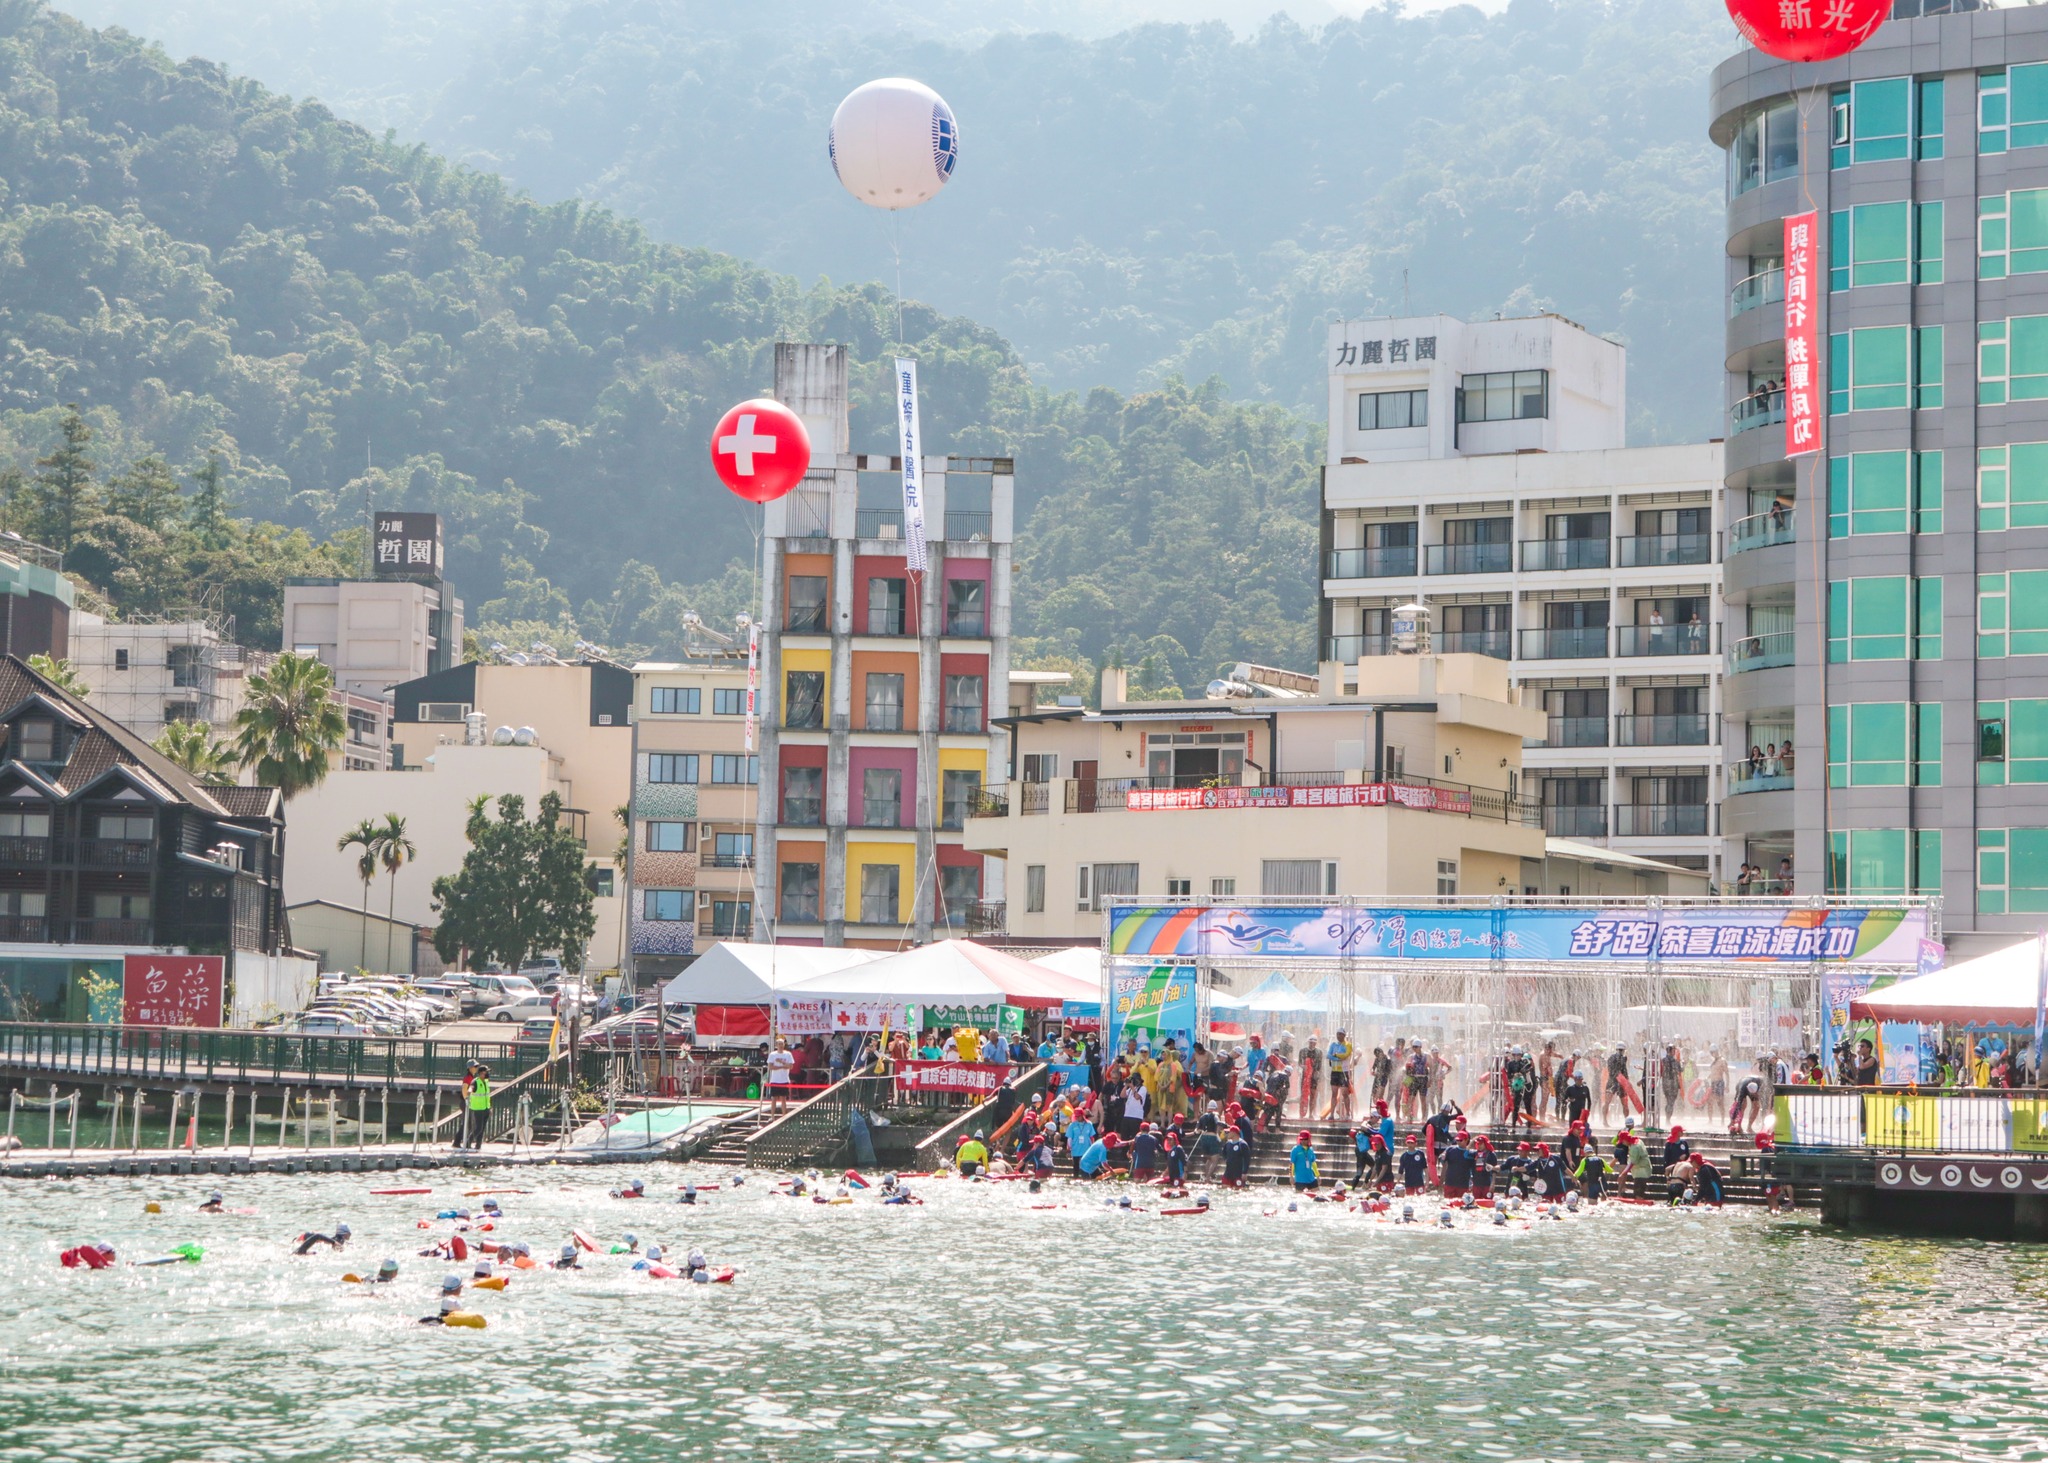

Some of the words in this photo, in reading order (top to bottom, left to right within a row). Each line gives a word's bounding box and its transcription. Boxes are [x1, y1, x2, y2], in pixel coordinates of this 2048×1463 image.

[1335, 336, 1437, 367] 力麗哲園
[379, 520, 403, 533] 力麗
[378, 538, 432, 565] 哲園
[1293, 786, 1386, 805] 萬客隆旅行社
[1570, 921, 1655, 955] 舒跑
[1659, 926, 1857, 955] 恭喜您泳渡成功
[1118, 976, 1148, 994] 舒跑
[792, 1002, 819, 1011] ARES
[1117, 983, 1188, 1013] 為你加油!
[152, 1008, 184, 1017] Fish
